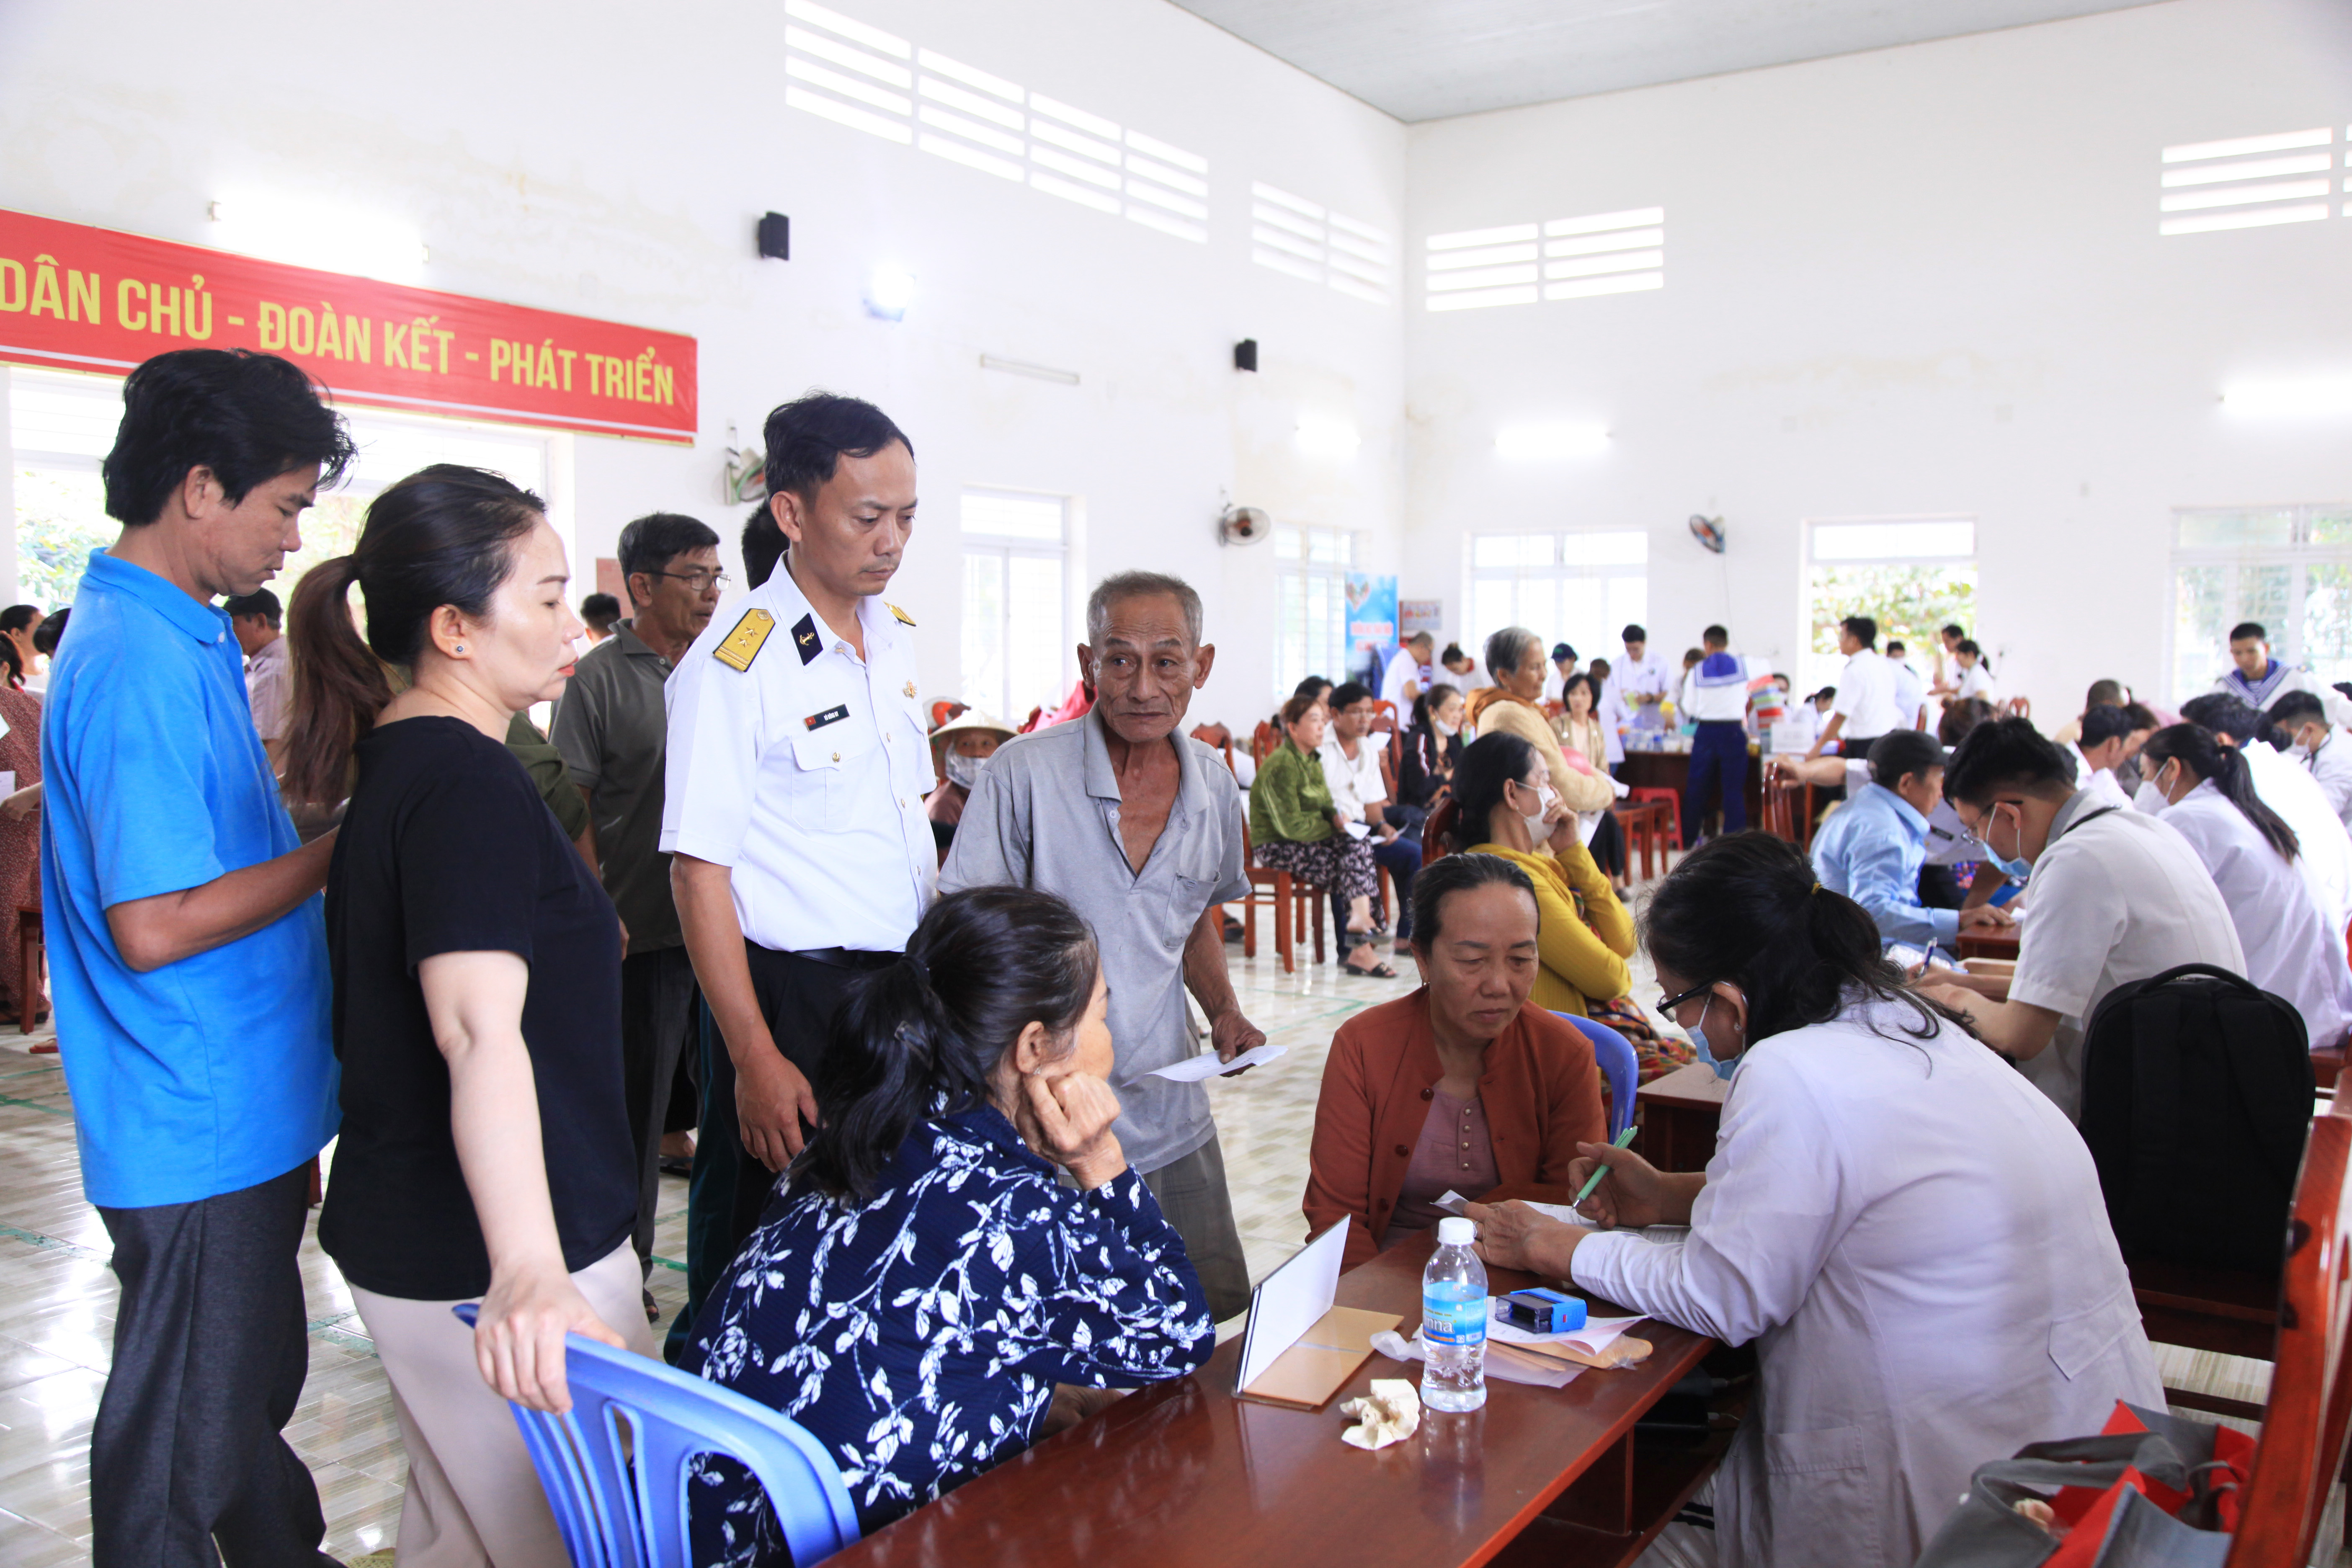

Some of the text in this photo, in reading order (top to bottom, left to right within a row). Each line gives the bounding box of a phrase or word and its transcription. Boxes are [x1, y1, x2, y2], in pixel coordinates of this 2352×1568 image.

[0, 253, 101, 325] DÂN
[118, 274, 212, 340] CHỦ
[258, 301, 371, 364] ĐOÀN
[384, 315, 455, 374] KẾT
[490, 338, 577, 392] PHÁT
[585, 346, 674, 405] TRIỂN
